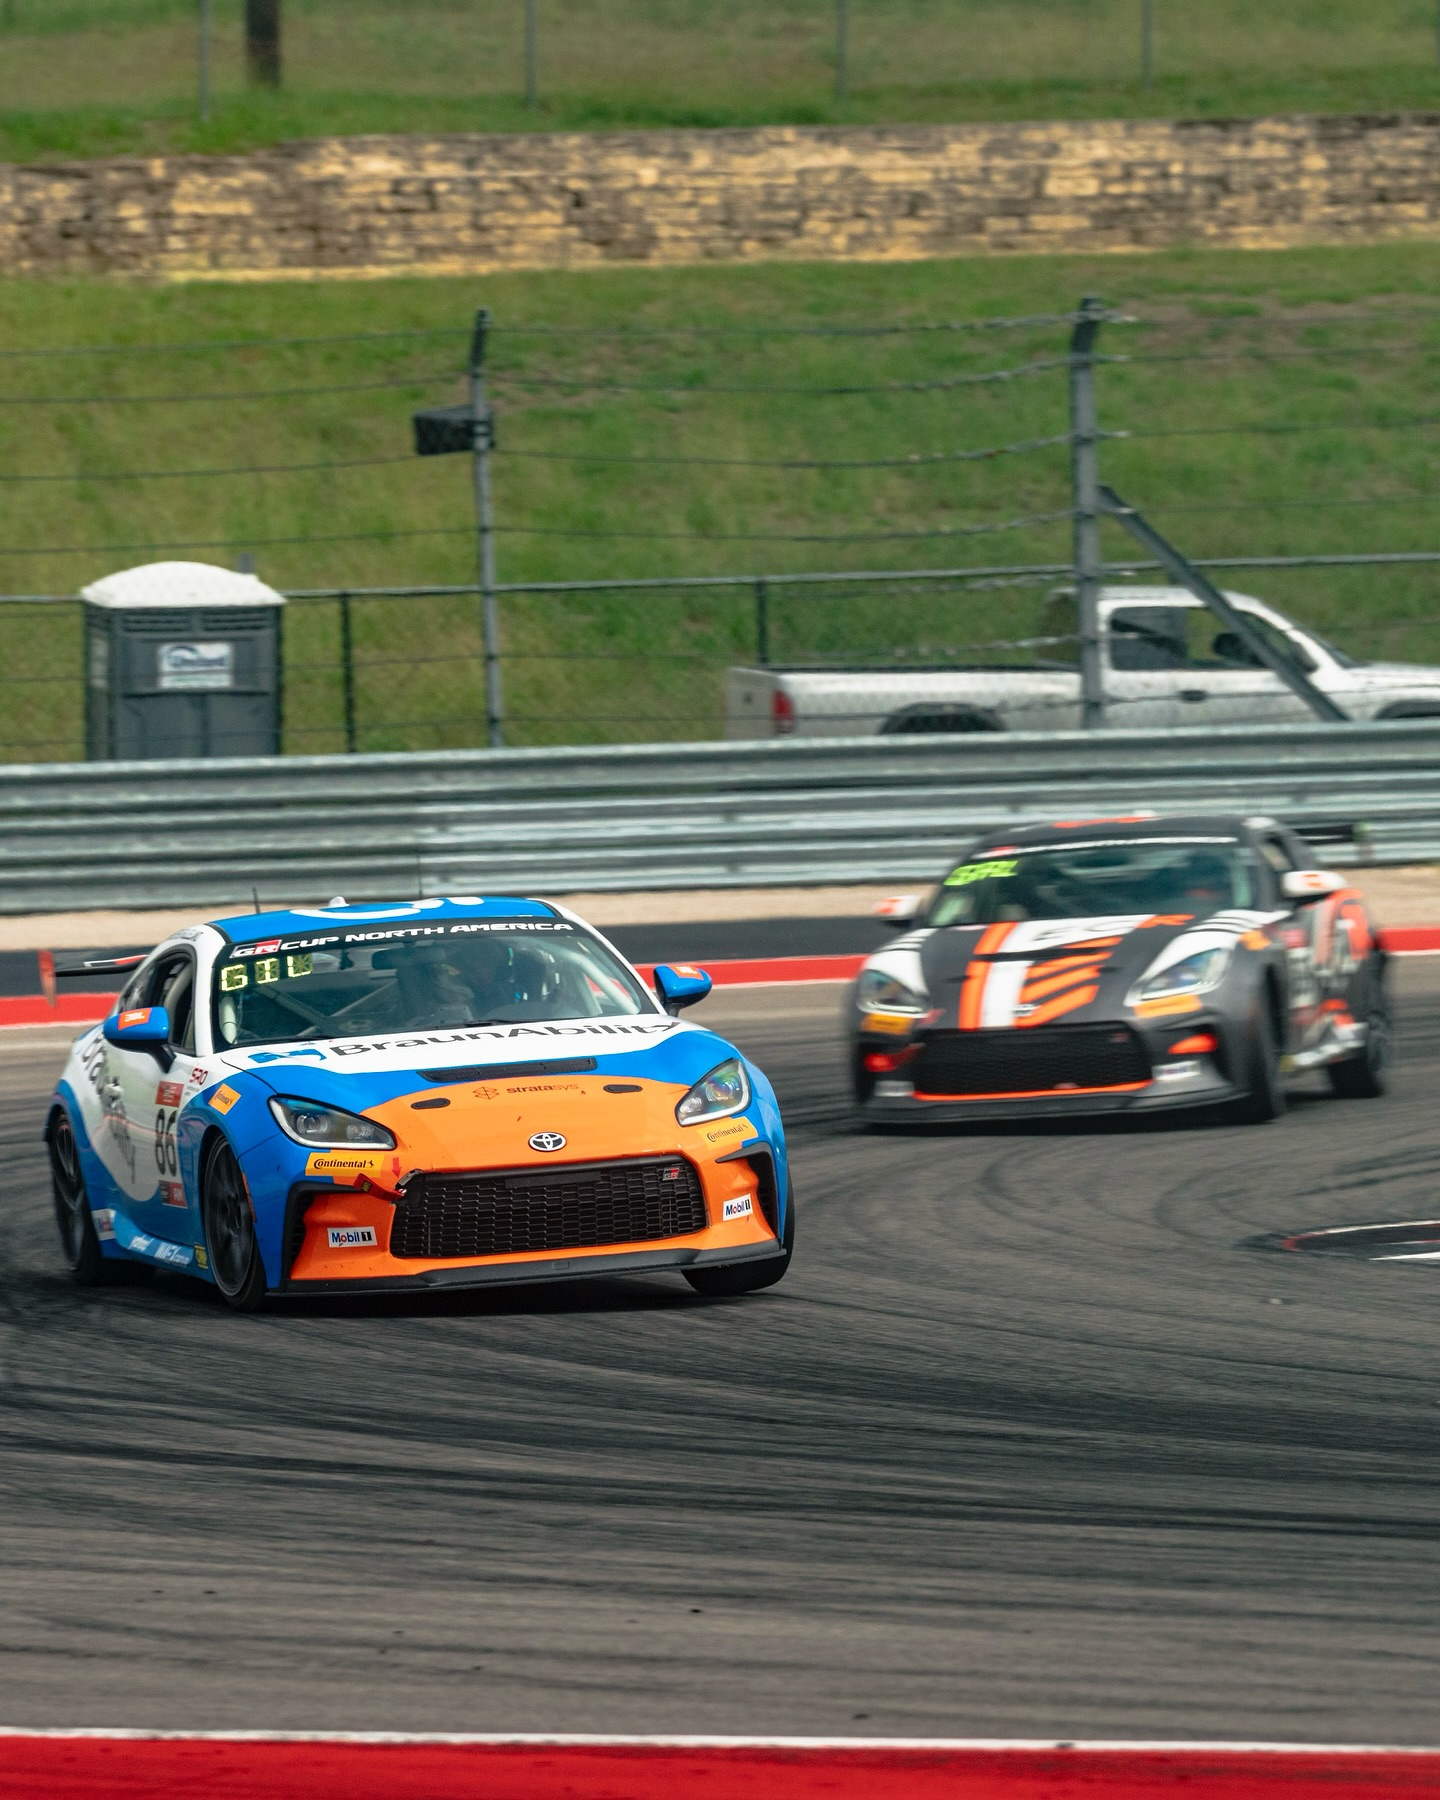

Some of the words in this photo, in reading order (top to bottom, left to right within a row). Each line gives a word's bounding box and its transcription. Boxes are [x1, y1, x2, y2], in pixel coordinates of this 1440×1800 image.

[231, 941, 280, 958] GR
[280, 936, 339, 951] CUP
[344, 926, 445, 943] NORTH
[449, 923, 574, 934] AMERICA
[221, 953, 314, 992] GIL
[329, 1022, 681, 1057] BraunAbility
[506, 1083, 579, 1095] stratasys
[155, 1108, 178, 1178] 86
[706, 1124, 745, 1143] Continental
[313, 1158, 367, 1170] Continental
[725, 1201, 746, 1216] Mobil
[331, 1231, 360, 1243] Mobil
[361, 1231, 373, 1242] 1
